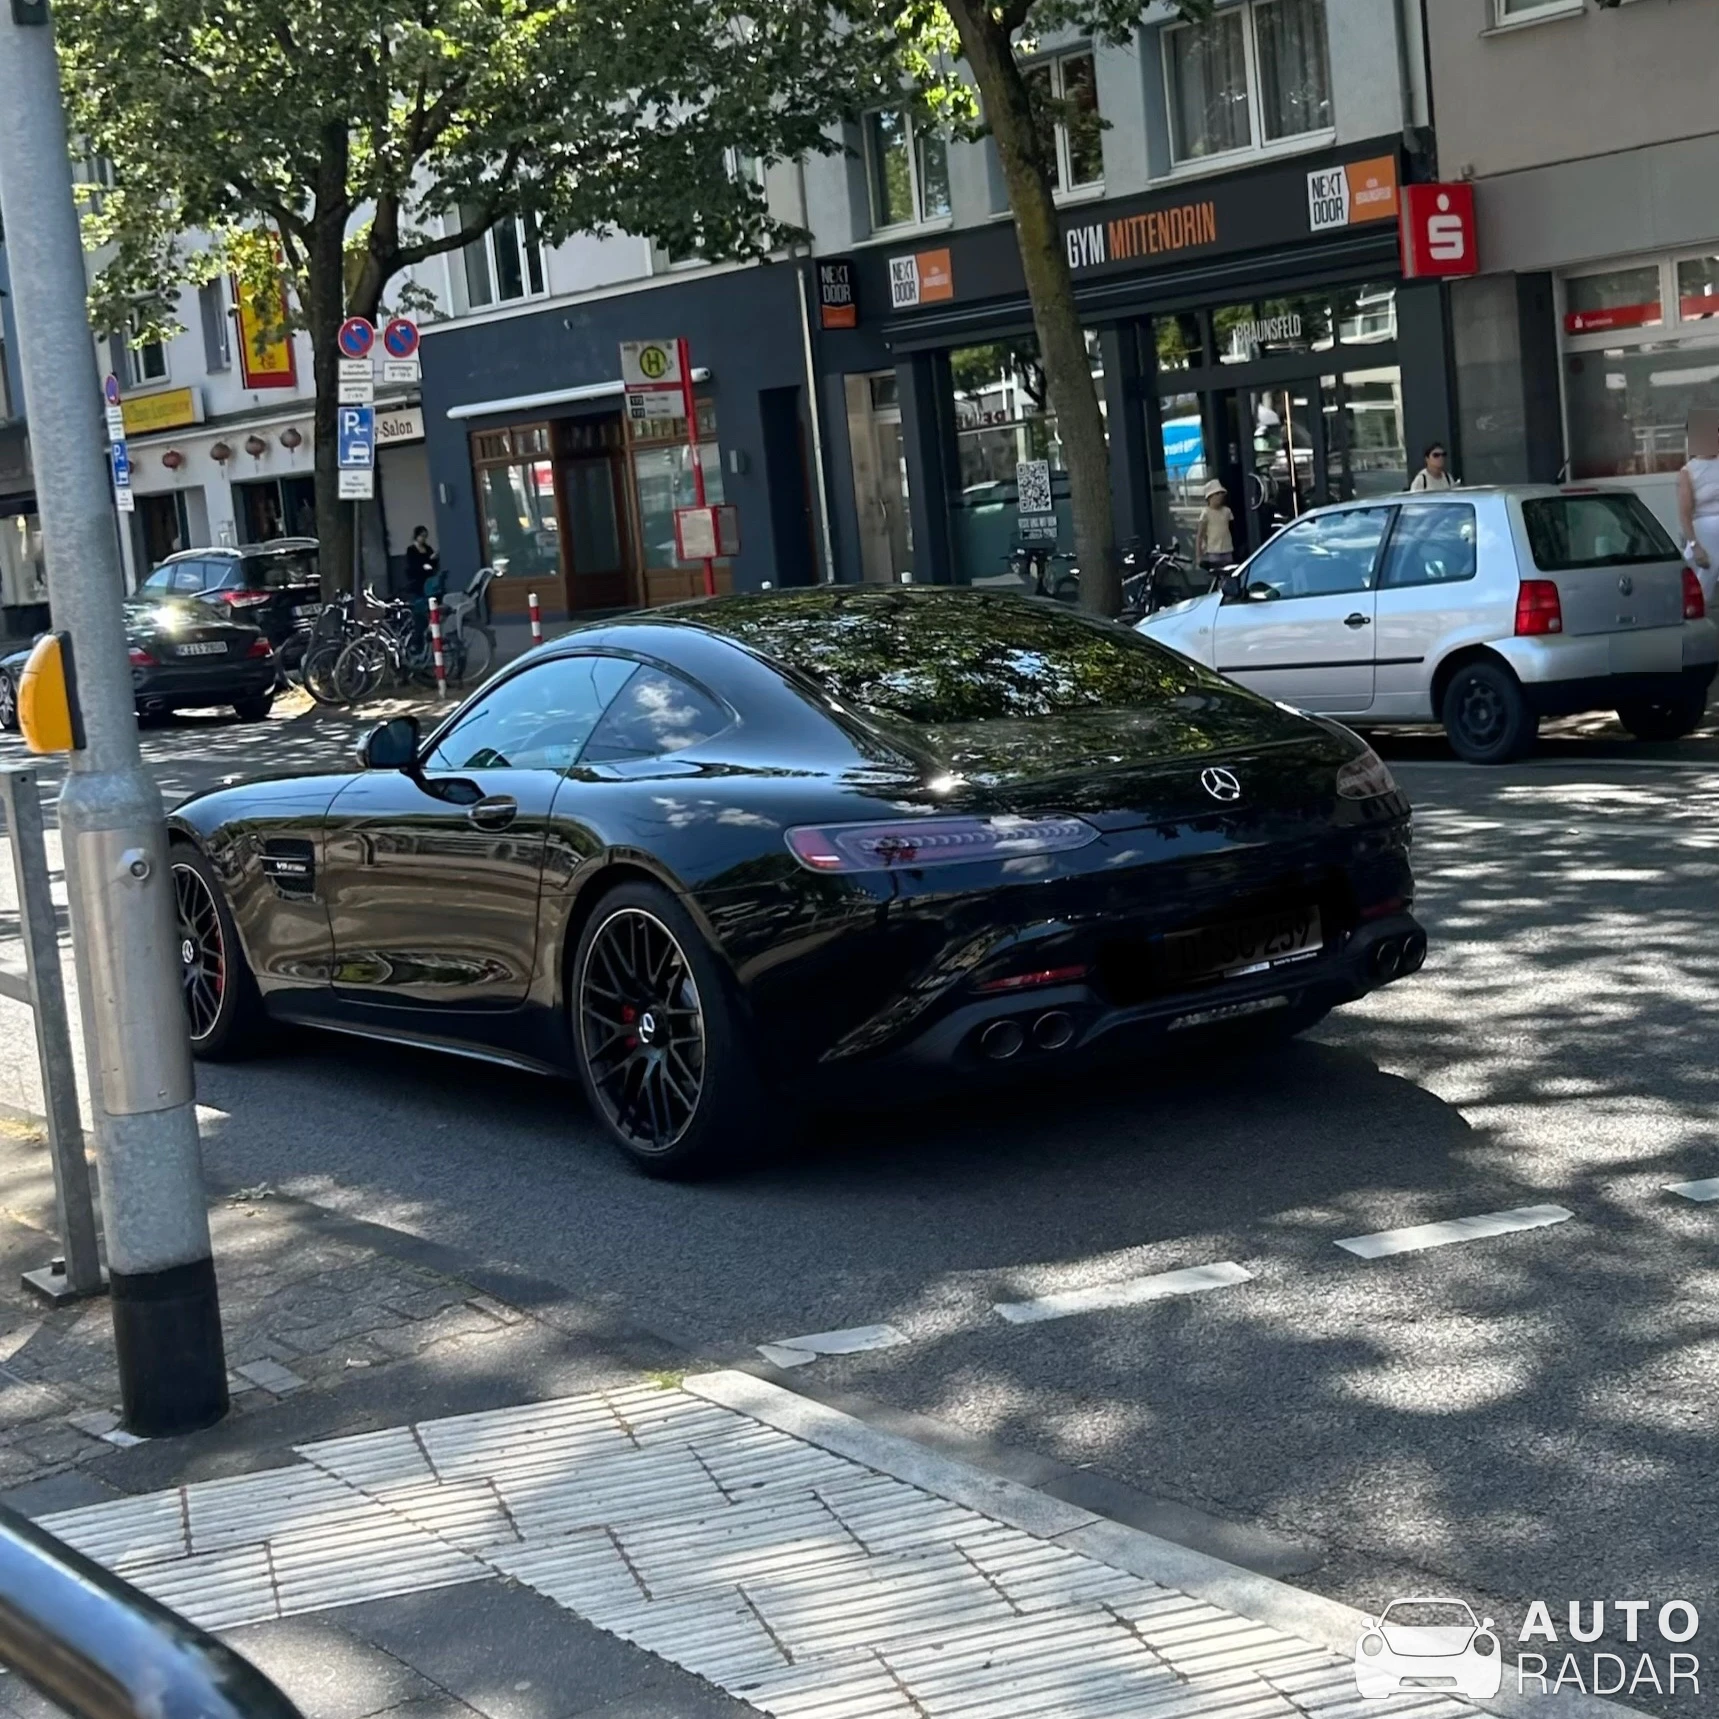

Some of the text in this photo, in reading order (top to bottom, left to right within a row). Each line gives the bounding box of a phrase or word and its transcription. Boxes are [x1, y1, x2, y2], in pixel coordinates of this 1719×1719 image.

[1312, 172, 1341, 199] NEXT
[1313, 197, 1344, 225] DOOR
[1066, 201, 1216, 268] GYM MITTENDRIN
[821, 265, 848, 283] NEXT
[892, 260, 914, 281] NEXT
[823, 284, 851, 303] DOOR
[894, 281, 917, 303] DOOR
[1236, 314, 1302, 343] BRAUNSFELD
[646, 352, 660, 373] H
[344, 411, 360, 435] P
